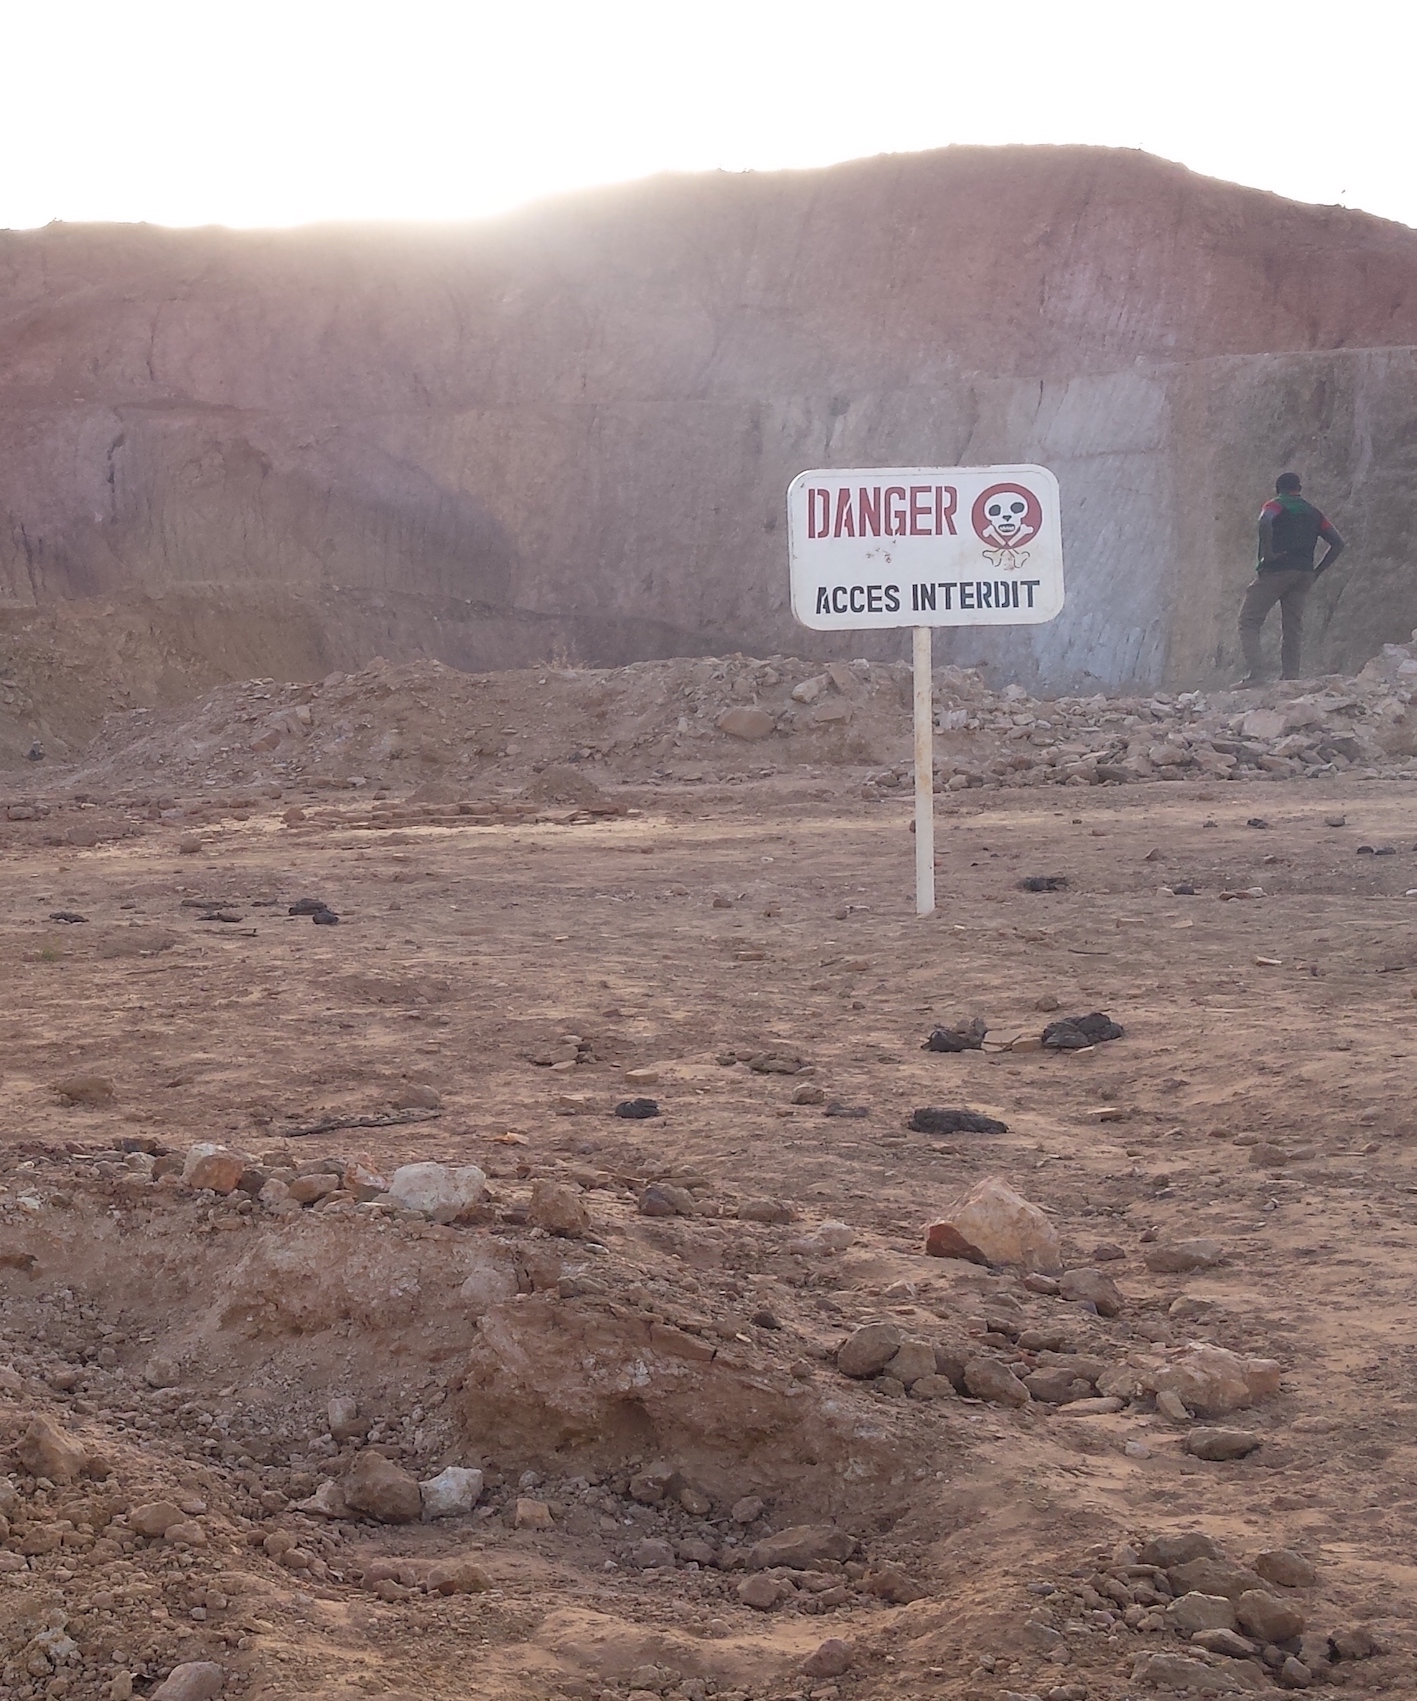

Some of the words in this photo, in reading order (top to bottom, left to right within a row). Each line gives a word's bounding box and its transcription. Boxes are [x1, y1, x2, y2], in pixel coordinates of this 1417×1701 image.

[808, 486, 958, 538] DANGER
[816, 584, 900, 614] ACCES
[912, 580, 1040, 611] INTERDIT
